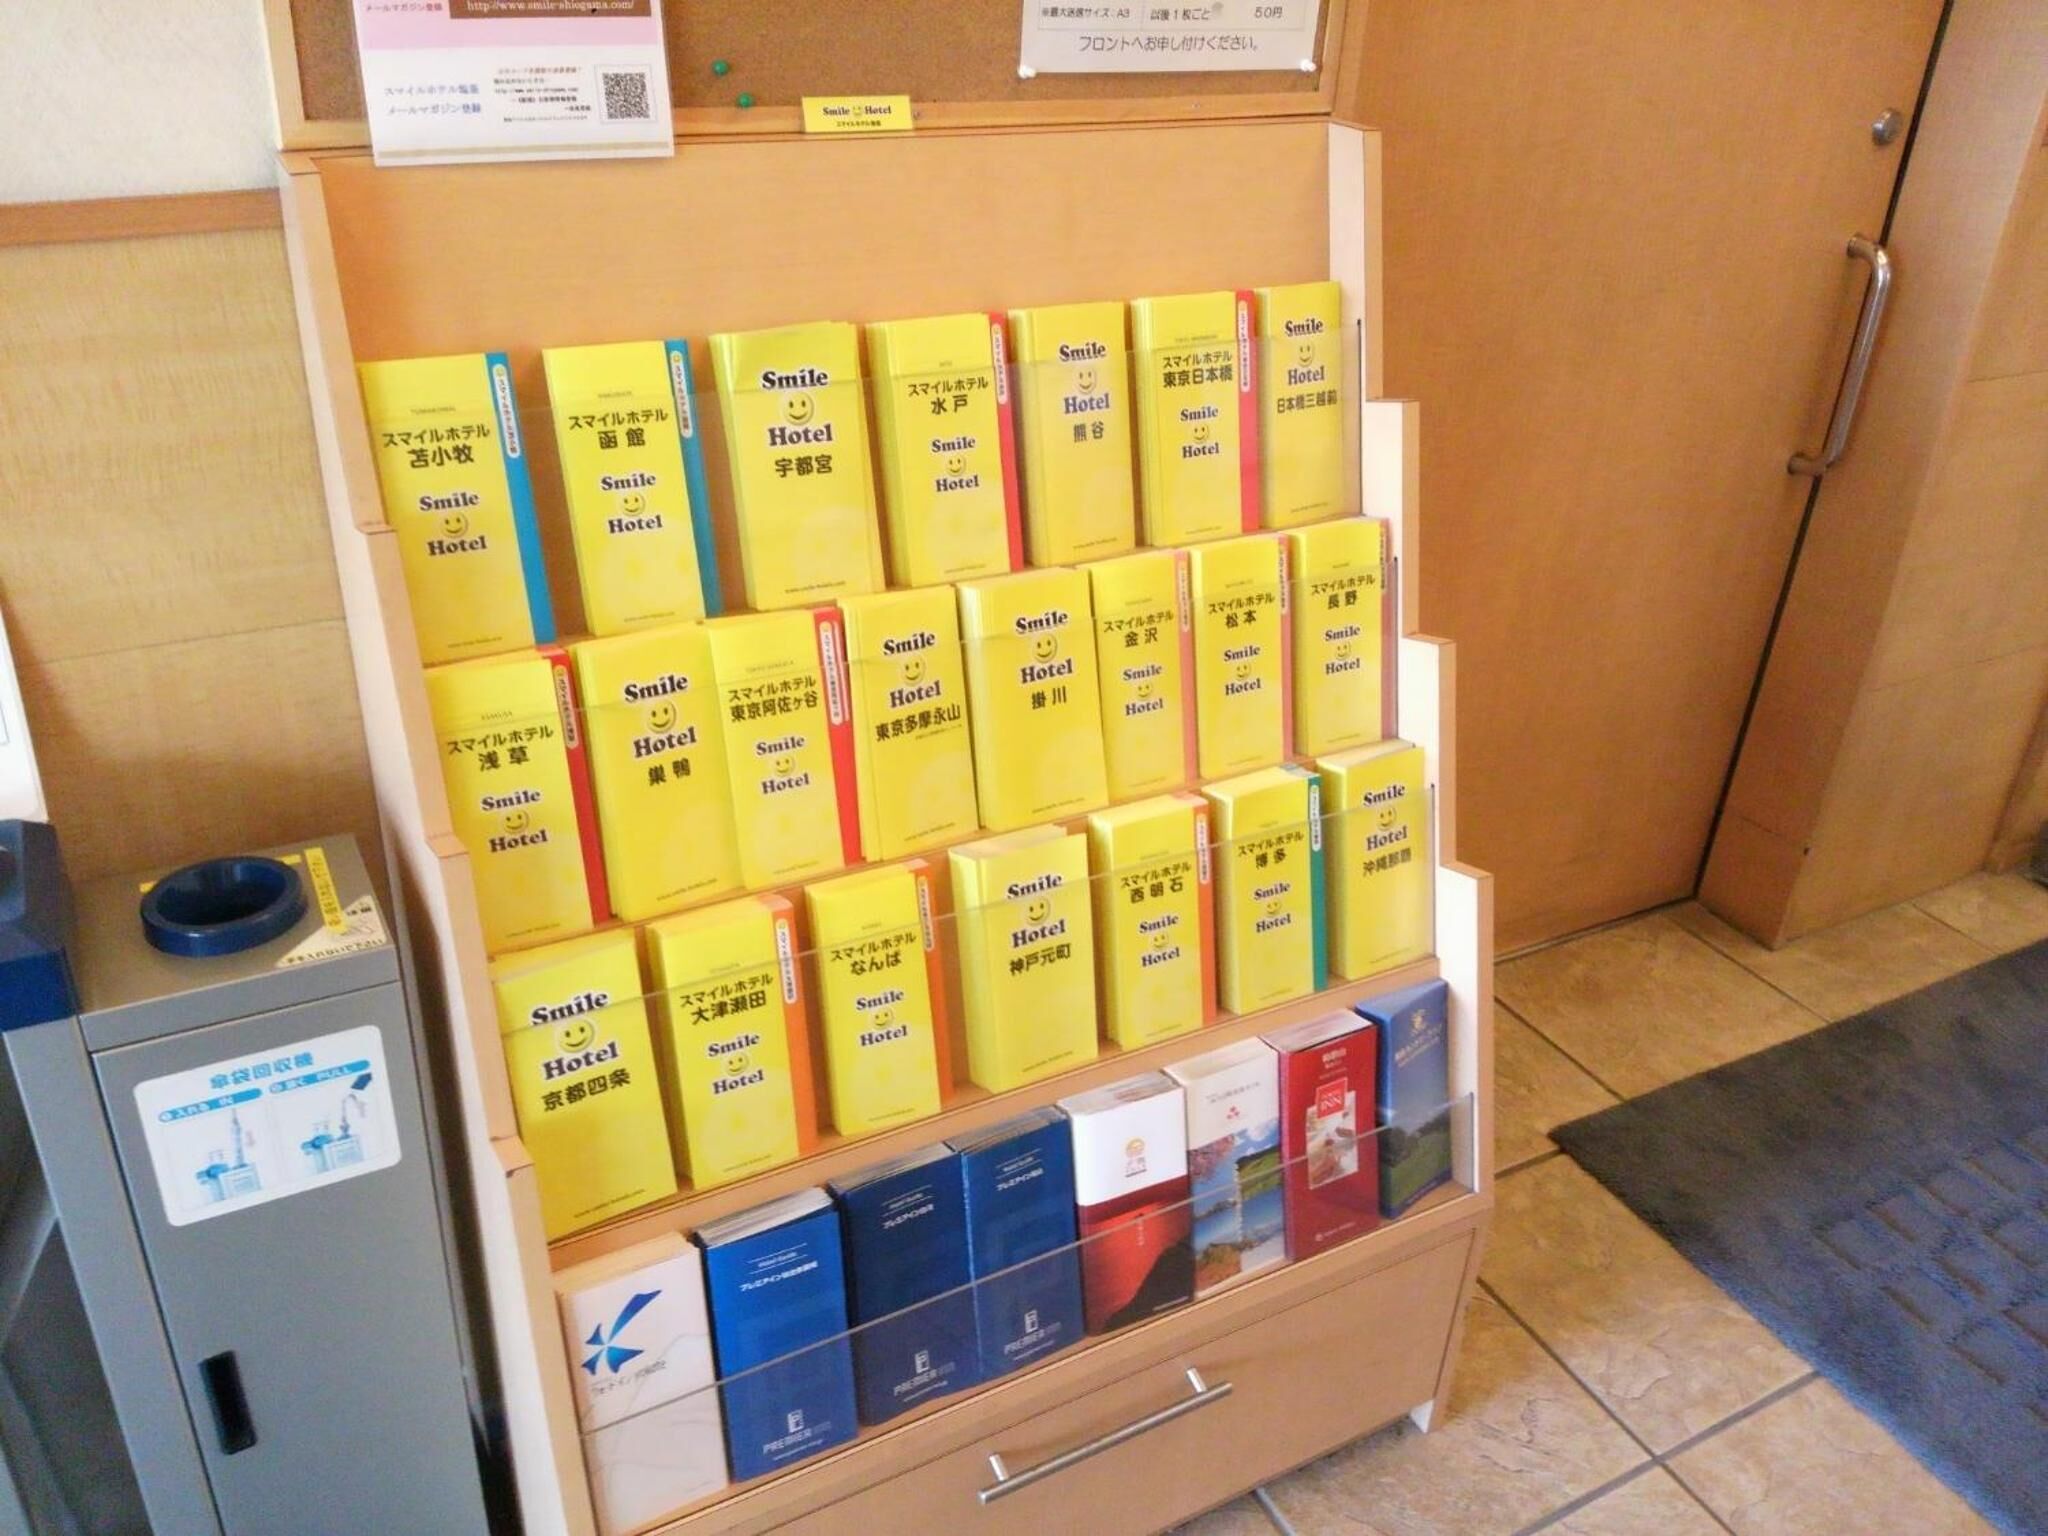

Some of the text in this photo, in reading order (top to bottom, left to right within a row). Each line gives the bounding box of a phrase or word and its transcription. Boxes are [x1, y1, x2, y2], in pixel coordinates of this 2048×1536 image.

[1079, 35, 1259, 52] フロントへお申し付けください。
[823, 105, 892, 116] Smile Hotel
[1285, 318, 1323, 335] Smile
[1059, 341, 1105, 361] Smile
[1163, 351, 1232, 370] スマイルホテル
[762, 369, 828, 389] Smile
[908, 377, 988, 396] スマイルホテル
[1164, 368, 1233, 388] 東京日本橋
[1288, 365, 1325, 386] Hotel
[931, 396, 968, 414] 水戸
[1064, 393, 1110, 415] Hotel
[1180, 405, 1218, 423] Smile
[569, 408, 668, 430] スマイルホテル
[383, 424, 490, 447] スマイルホテル
[599, 428, 646, 450] 函館
[768, 425, 832, 446] Hotel
[1074, 421, 1104, 442] 熊谷
[931, 436, 975, 452] Smile
[1182, 443, 1219, 459] Hotel
[408, 445, 474, 469] 苫小牧
[775, 455, 832, 477] 宇都宮
[601, 473, 656, 491] Smile
[936, 476, 979, 492] Hotel
[419, 492, 479, 512] Smile
[608, 515, 662, 534] Hotel
[427, 537, 487, 556] Hotel
[1311, 573, 1375, 596] スマイルホテル
[1208, 592, 1275, 615] スマイルホテル
[1327, 590, 1357, 610] 長野
[1015, 611, 1068, 633] Smile
[1104, 609, 1174, 633] スマイルホテル
[1225, 610, 1257, 628] 松本
[884, 632, 935, 656] Smile
[1124, 628, 1158, 648] 金沢
[1325, 625, 1360, 642] Smile
[1223, 645, 1260, 662] Smile
[1020, 659, 1073, 684] Hotel
[1123, 664, 1162, 681] Smile
[1325, 658, 1360, 675] Hotel
[624, 675, 688, 701] Smile
[728, 676, 816, 702] スマイルホテル
[890, 680, 941, 709] Hotel
[1032, 686, 1067, 709] 掛川
[1225, 678, 1261, 696] Hotel
[1125, 698, 1163, 716] Hotel
[875, 703, 960, 743] 東京多摩永山
[447, 725, 554, 755] スマイルホテル
[633, 727, 697, 758] Hotel
[756, 736, 805, 757] Smile
[478, 746, 530, 771] 浅草
[648, 758, 691, 787] 巣鴨
[762, 773, 810, 795] Hotel
[481, 790, 541, 810] Smile
[1363, 785, 1405, 807] Smile
[489, 829, 548, 853] Hotel
[1238, 831, 1304, 857] スマイルホテル
[1367, 825, 1407, 851] Hotel
[1255, 849, 1286, 870] 博多
[1007, 874, 1062, 898] Smile
[1120, 862, 1191, 889] スマイルホテル
[1130, 879, 1184, 903] 西明石
[1254, 881, 1290, 901] Smile
[1012, 920, 1066, 948] Hotel
[1139, 914, 1179, 934] Smile
[1256, 913, 1291, 934] Hotel
[831, 932, 916, 962] スマイルホテル
[1141, 946, 1180, 968] Hotel
[851, 951, 901, 976] なんば
[1009, 943, 1071, 976] 神戸元町
[680, 973, 773, 1007] スマイルホテル
[856, 990, 904, 1010] Smile
[532, 991, 608, 1026] Smile
[691, 990, 766, 1026] 大津瀬田
[708, 1034, 760, 1056] Smile
[860, 1025, 907, 1047] Hotel
[543, 1042, 619, 1081] Hotel
[541, 1067, 631, 1113] 京都四条
[712, 1070, 764, 1095] Hotel
